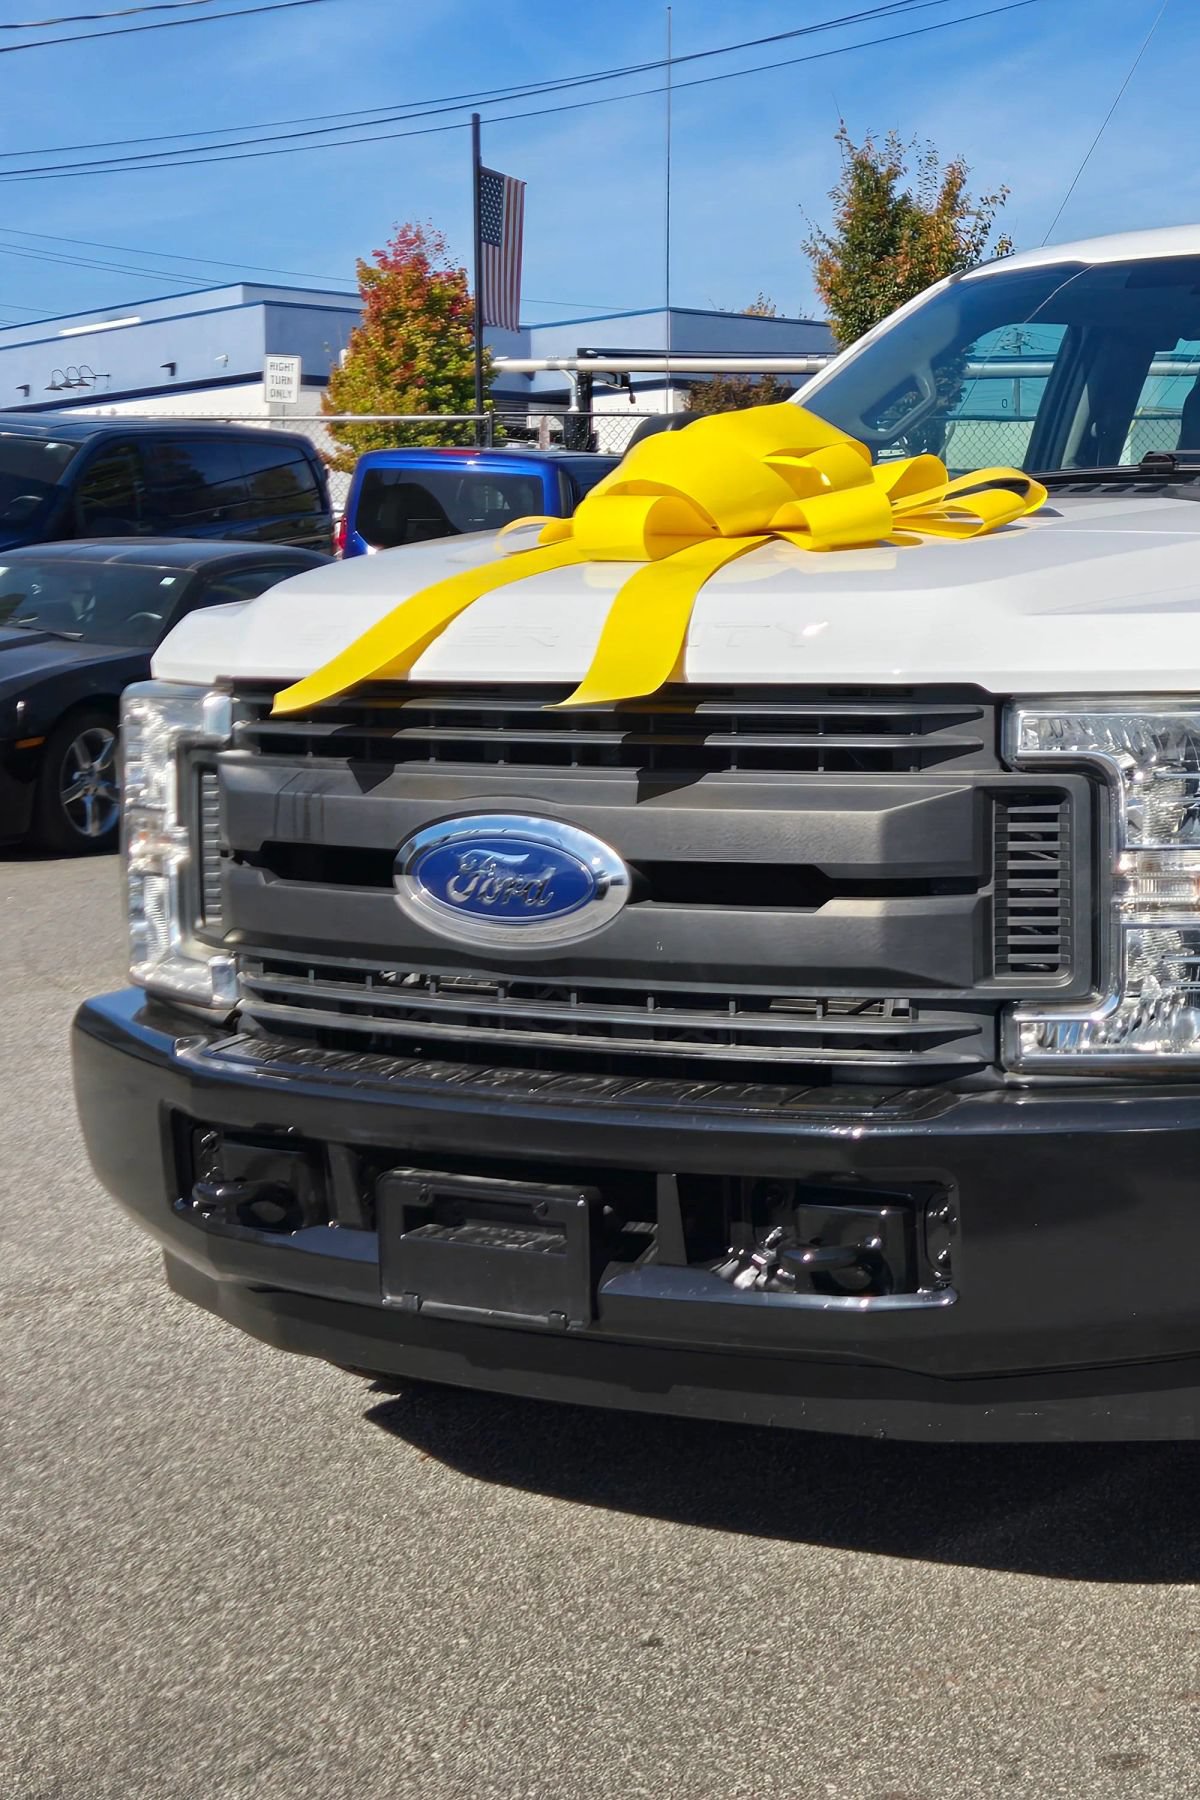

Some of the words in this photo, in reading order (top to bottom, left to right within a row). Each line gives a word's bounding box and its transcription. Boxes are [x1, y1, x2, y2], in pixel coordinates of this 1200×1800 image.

[270, 361, 295, 371] RIGHT
[270, 375, 293, 385] TURN
[270, 388, 292, 399] ONLY
[446, 849, 557, 907] Ford
